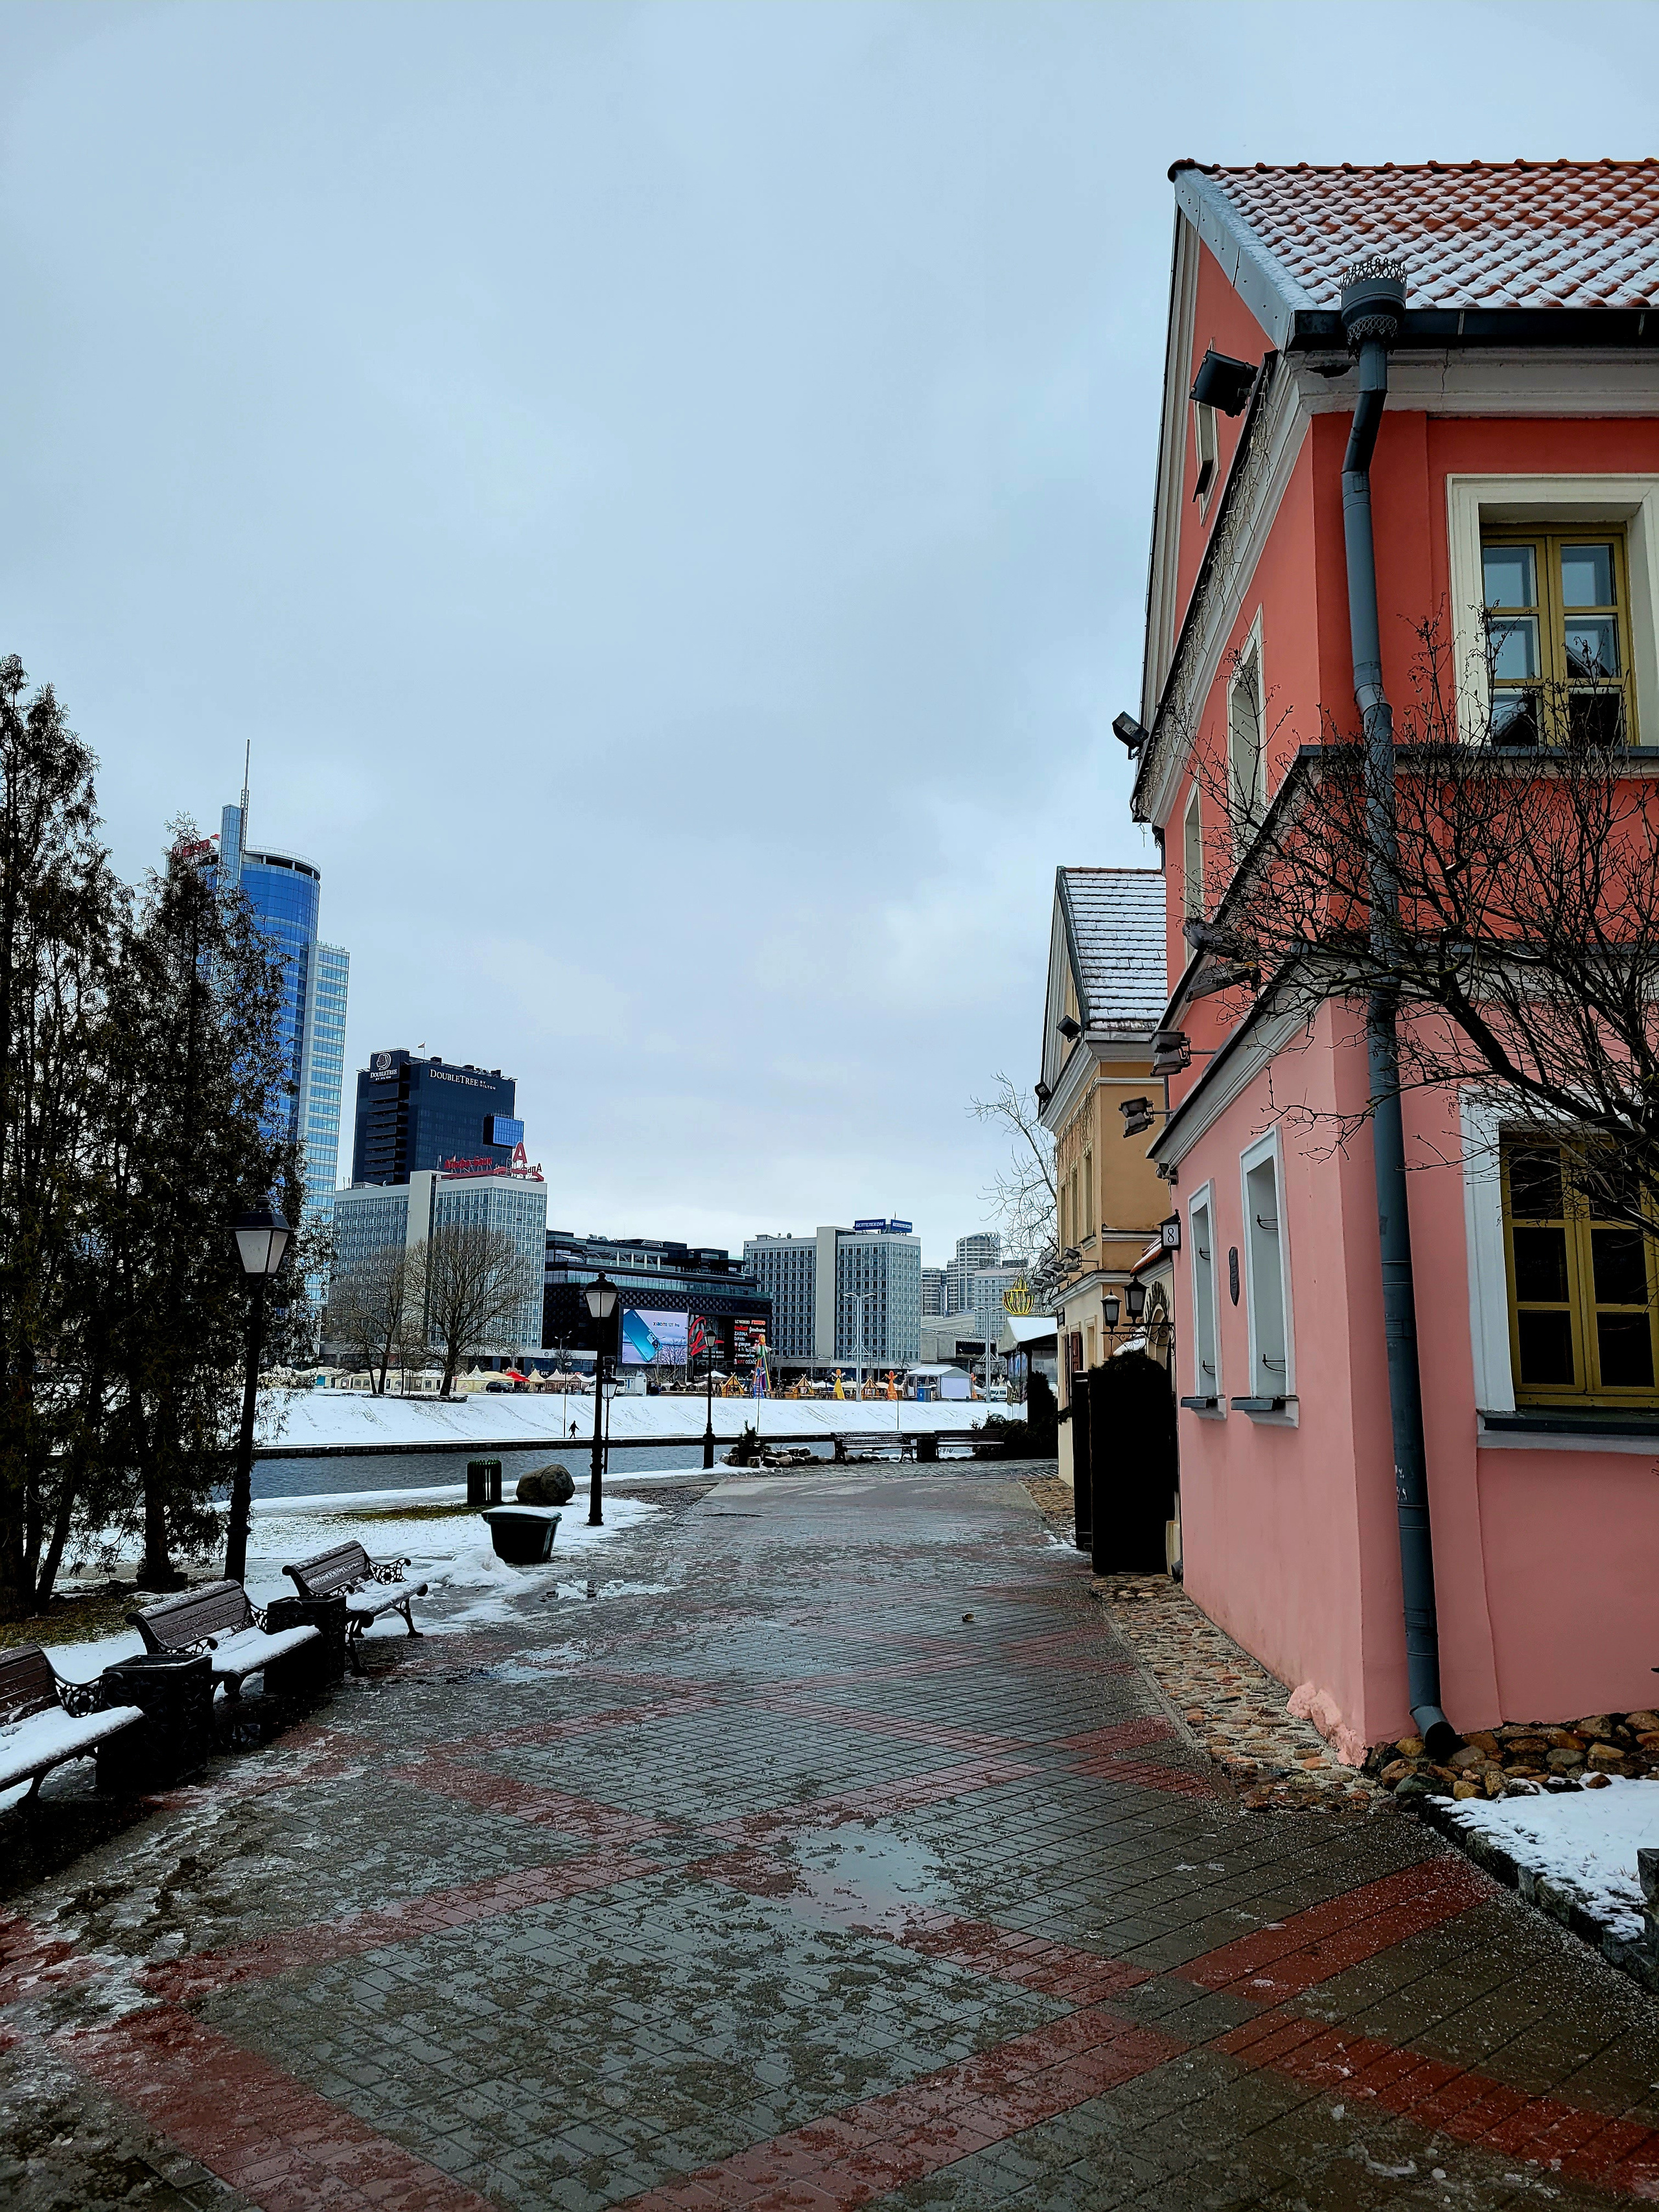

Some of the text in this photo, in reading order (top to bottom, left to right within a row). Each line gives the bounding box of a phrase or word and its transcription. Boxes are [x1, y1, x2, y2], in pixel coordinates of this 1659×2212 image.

[370, 1069, 398, 1078] DOUBLETREE
[430, 1069, 479, 1086] DOUBLETREE
[1167, 1228, 1175, 1243] 8
